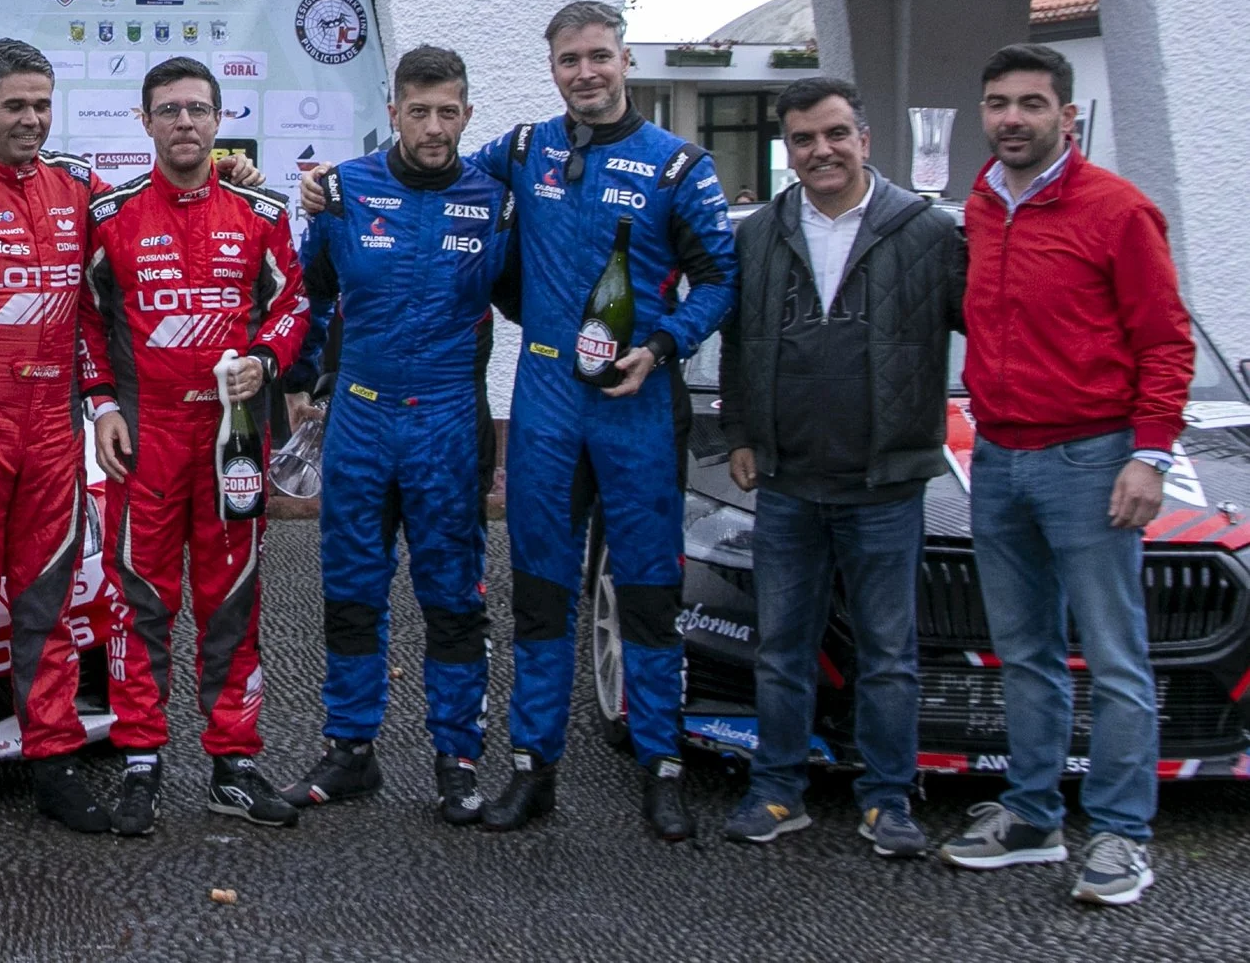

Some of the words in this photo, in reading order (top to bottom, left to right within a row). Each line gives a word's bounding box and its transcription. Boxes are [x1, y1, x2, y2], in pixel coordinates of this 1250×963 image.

[300, 38, 359, 64] PUBLICIDADE
[223, 64, 259, 77] CORAL
[97, 154, 149, 164] CASSIANOS
[604, 157, 656, 178] ZEISS
[601, 187, 647, 209] MEO
[94, 201, 117, 219] OMP
[254, 201, 280, 219] OMP
[443, 202, 490, 220] ZEISS
[140, 237, 161, 247] elf
[211, 231, 245, 241] LOTES
[441, 235, 483, 254] MEO
[136, 252, 180, 263] CASSIANO'S
[136, 287, 242, 312] LOTES
[577, 334, 614, 357] CORAL
[224, 477, 260, 492] CORAL
